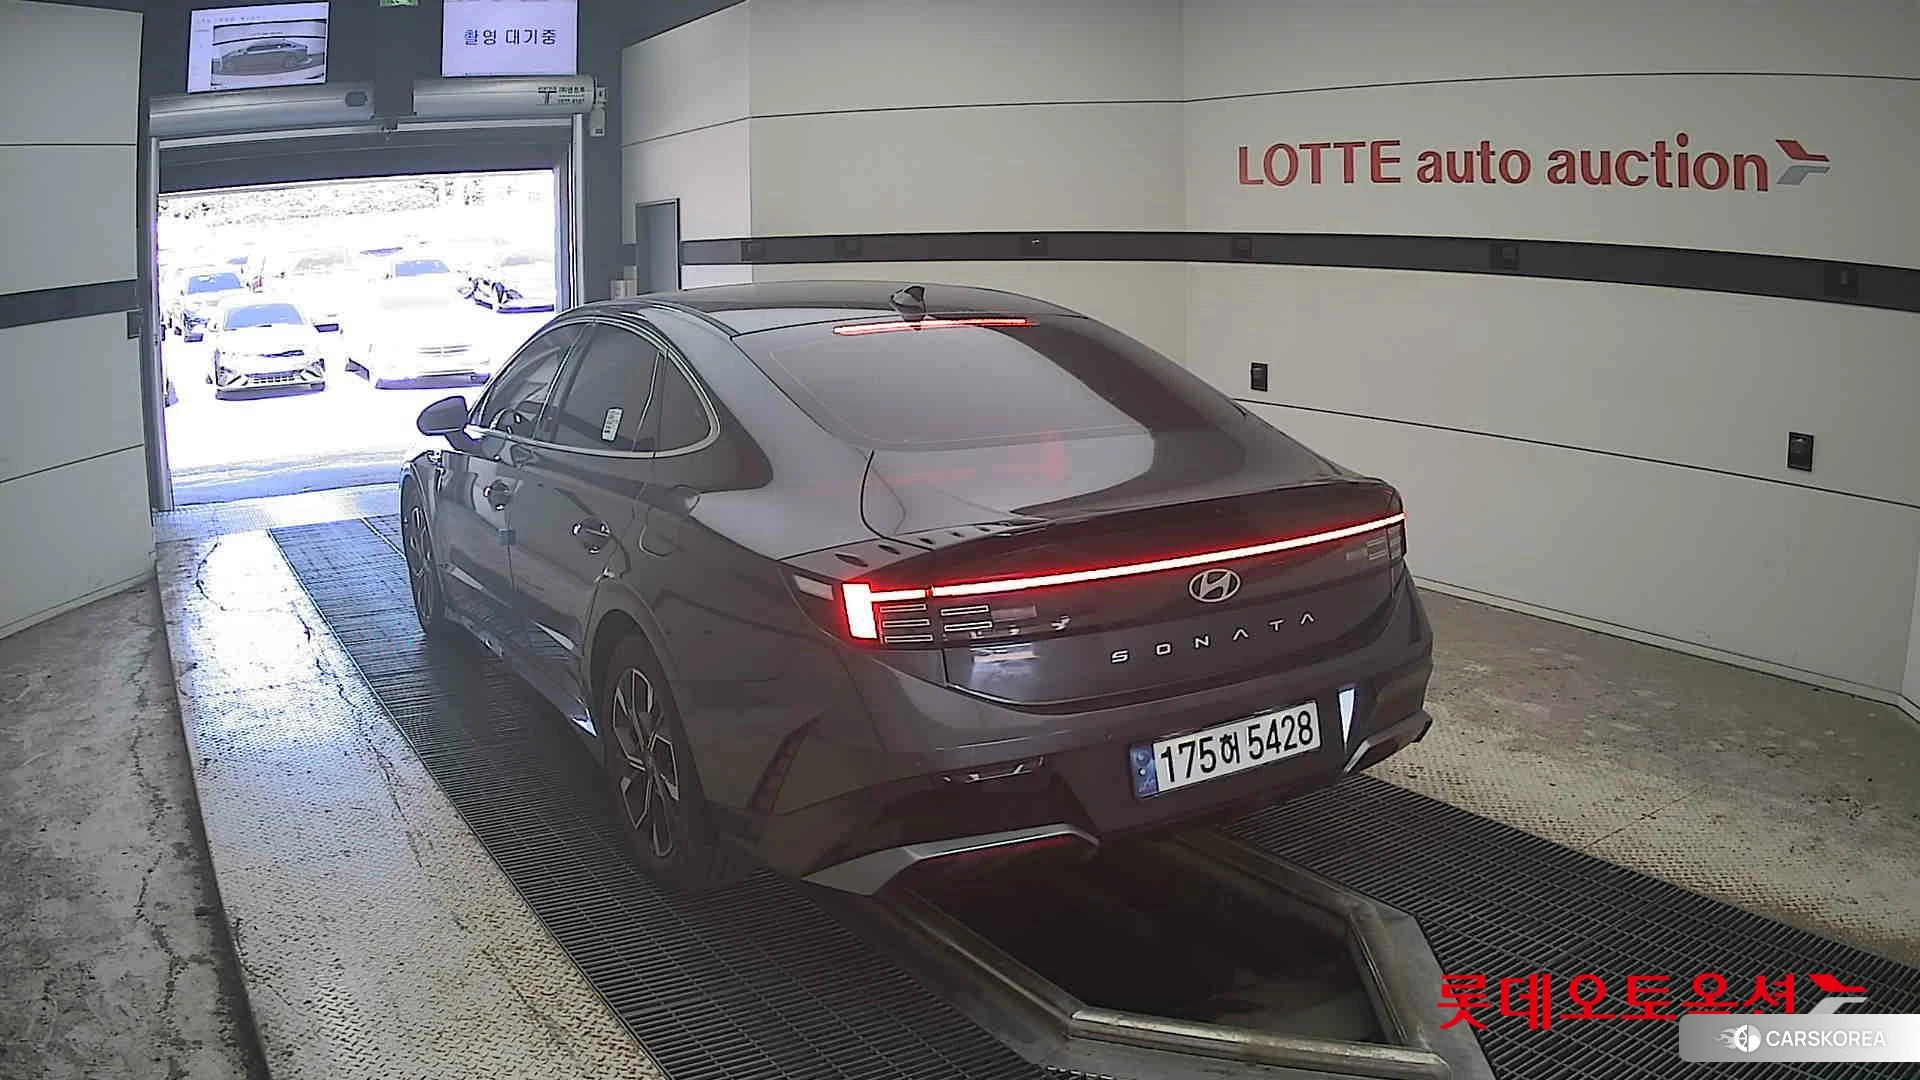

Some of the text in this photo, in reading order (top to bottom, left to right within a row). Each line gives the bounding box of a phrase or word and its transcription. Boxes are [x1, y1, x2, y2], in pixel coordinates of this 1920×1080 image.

[505, 29, 557, 45] 대기중
[1237, 132, 1769, 193] LOTTE auto auction
[1111, 613, 1316, 664] SONATA
[1160, 710, 1314, 783] 175허 5428
